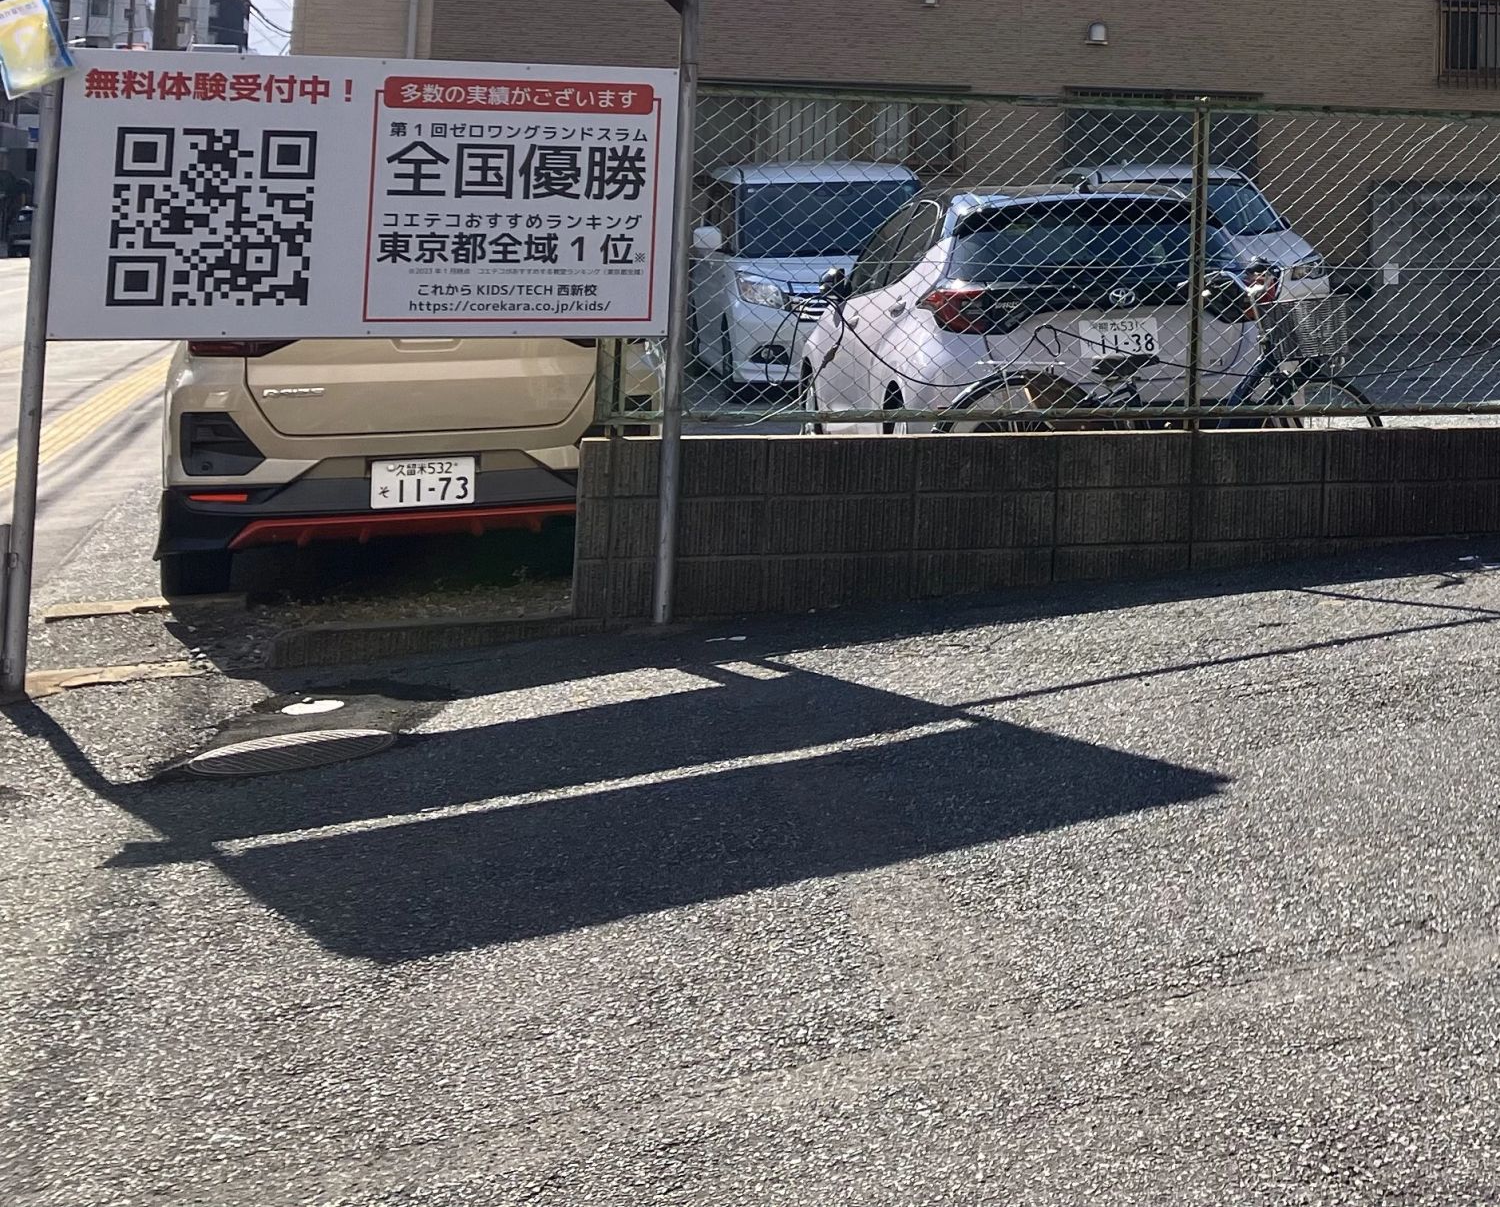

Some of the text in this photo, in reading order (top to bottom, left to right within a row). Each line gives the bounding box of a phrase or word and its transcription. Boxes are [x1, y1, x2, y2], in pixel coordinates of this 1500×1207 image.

[85, 68, 353, 105] 無料体験受付中！
[400, 82, 637, 109] 多数の実績がございます
[385, 140, 647, 201] 全国優勝
[382, 212, 643, 231] コエテコおすすめランキング
[417, 284, 598, 297] これから KIDS/TECH 西新校
[408, 300, 613, 314] https://corekara.co.jp/kids/
[399, 476, 469, 503] 11-73
